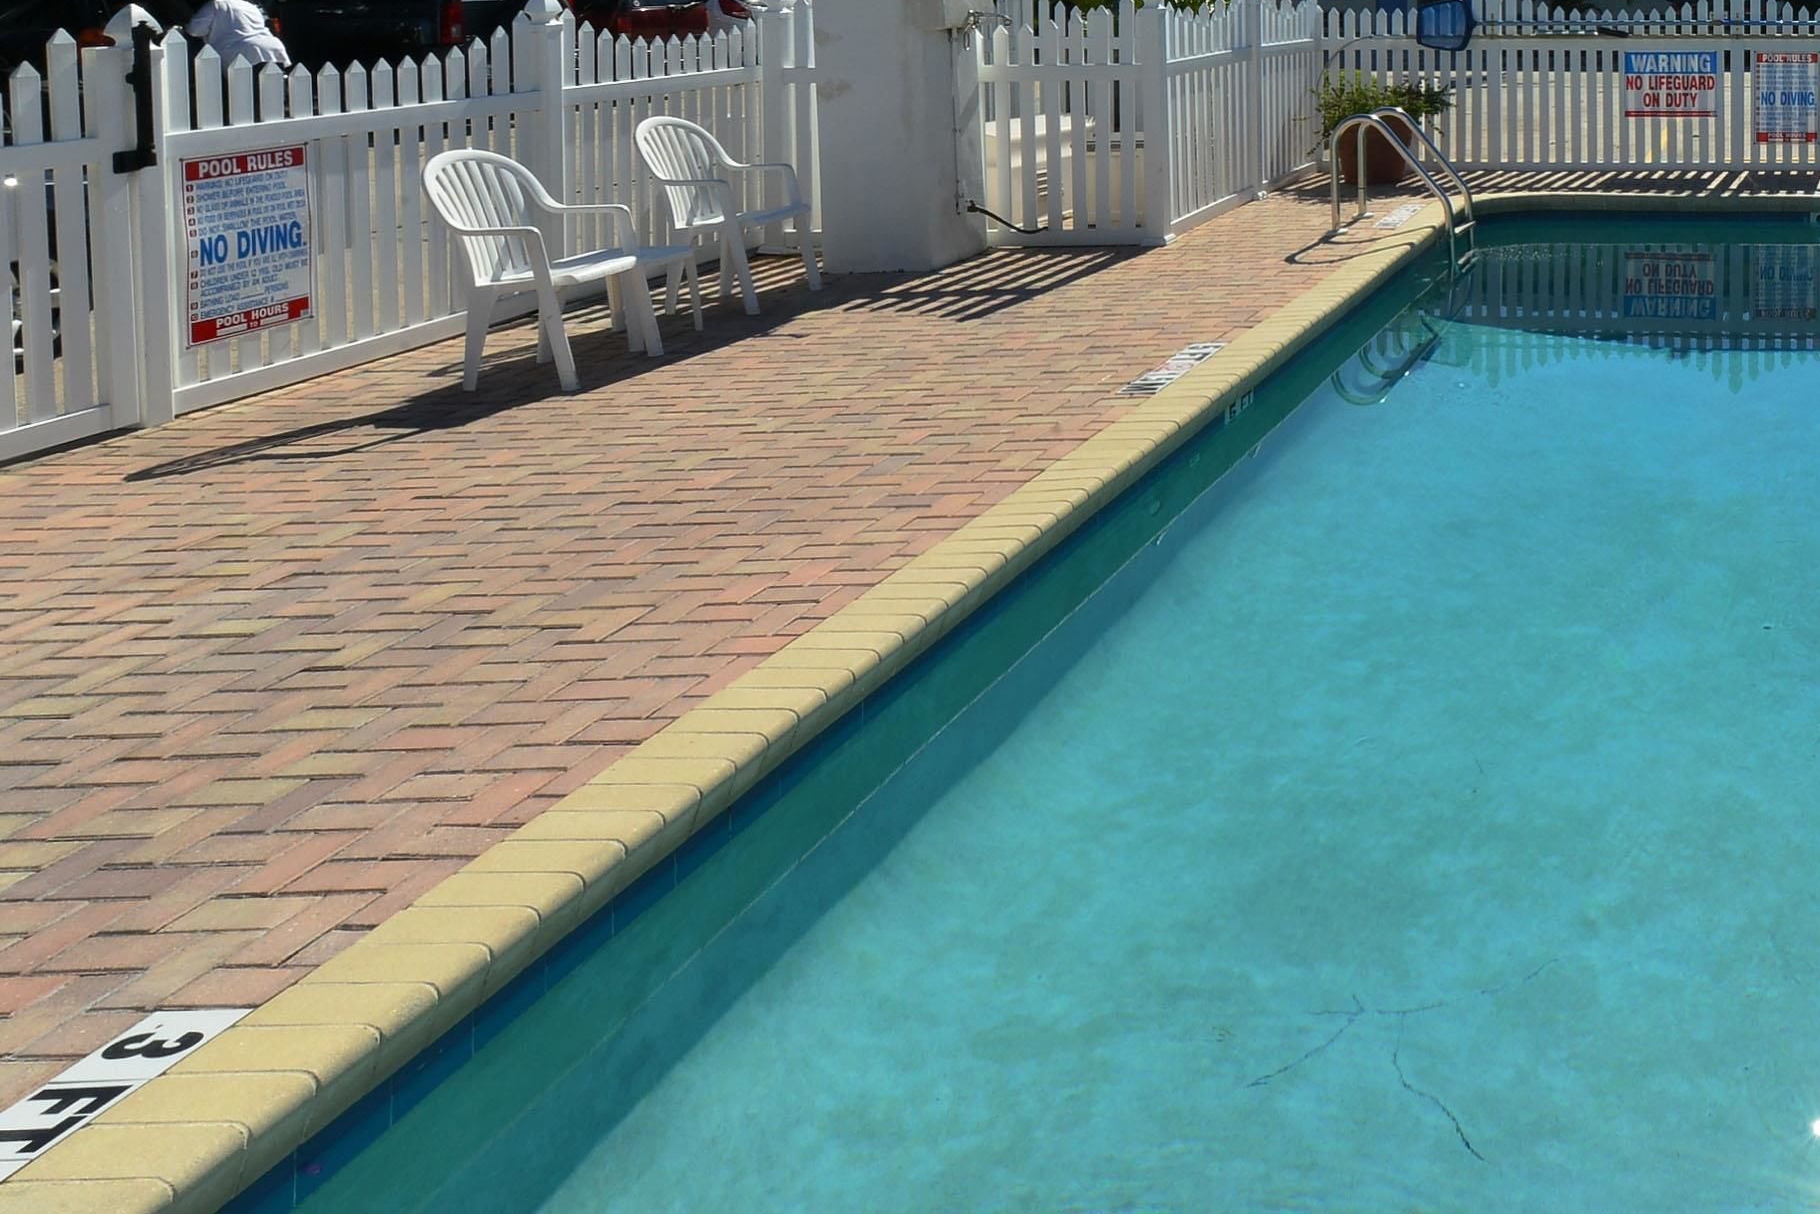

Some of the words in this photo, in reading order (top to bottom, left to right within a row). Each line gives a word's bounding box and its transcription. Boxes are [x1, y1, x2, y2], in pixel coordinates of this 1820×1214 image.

[1631, 54, 1711, 73] WARNING
[1762, 53, 1785, 63] POOL
[1787, 53, 1812, 63] RULES
[1626, 76, 1643, 90] NO
[1648, 76, 1715, 90] LIFEGUARD
[1643, 93, 1660, 107] ON
[1665, 93, 1698, 107] DUTY
[1761, 91, 1776, 106] NO
[199, 158, 241, 178] POOL
[247, 151, 292, 172] RULES
[200, 234, 228, 266] NO
[237, 220, 307, 259] DIVING.
[216, 314, 247, 328] POOL
[251, 303, 289, 319] HOURS
[102, 1032, 204, 1060] 3
[0, 1084, 133, 1154] FT
